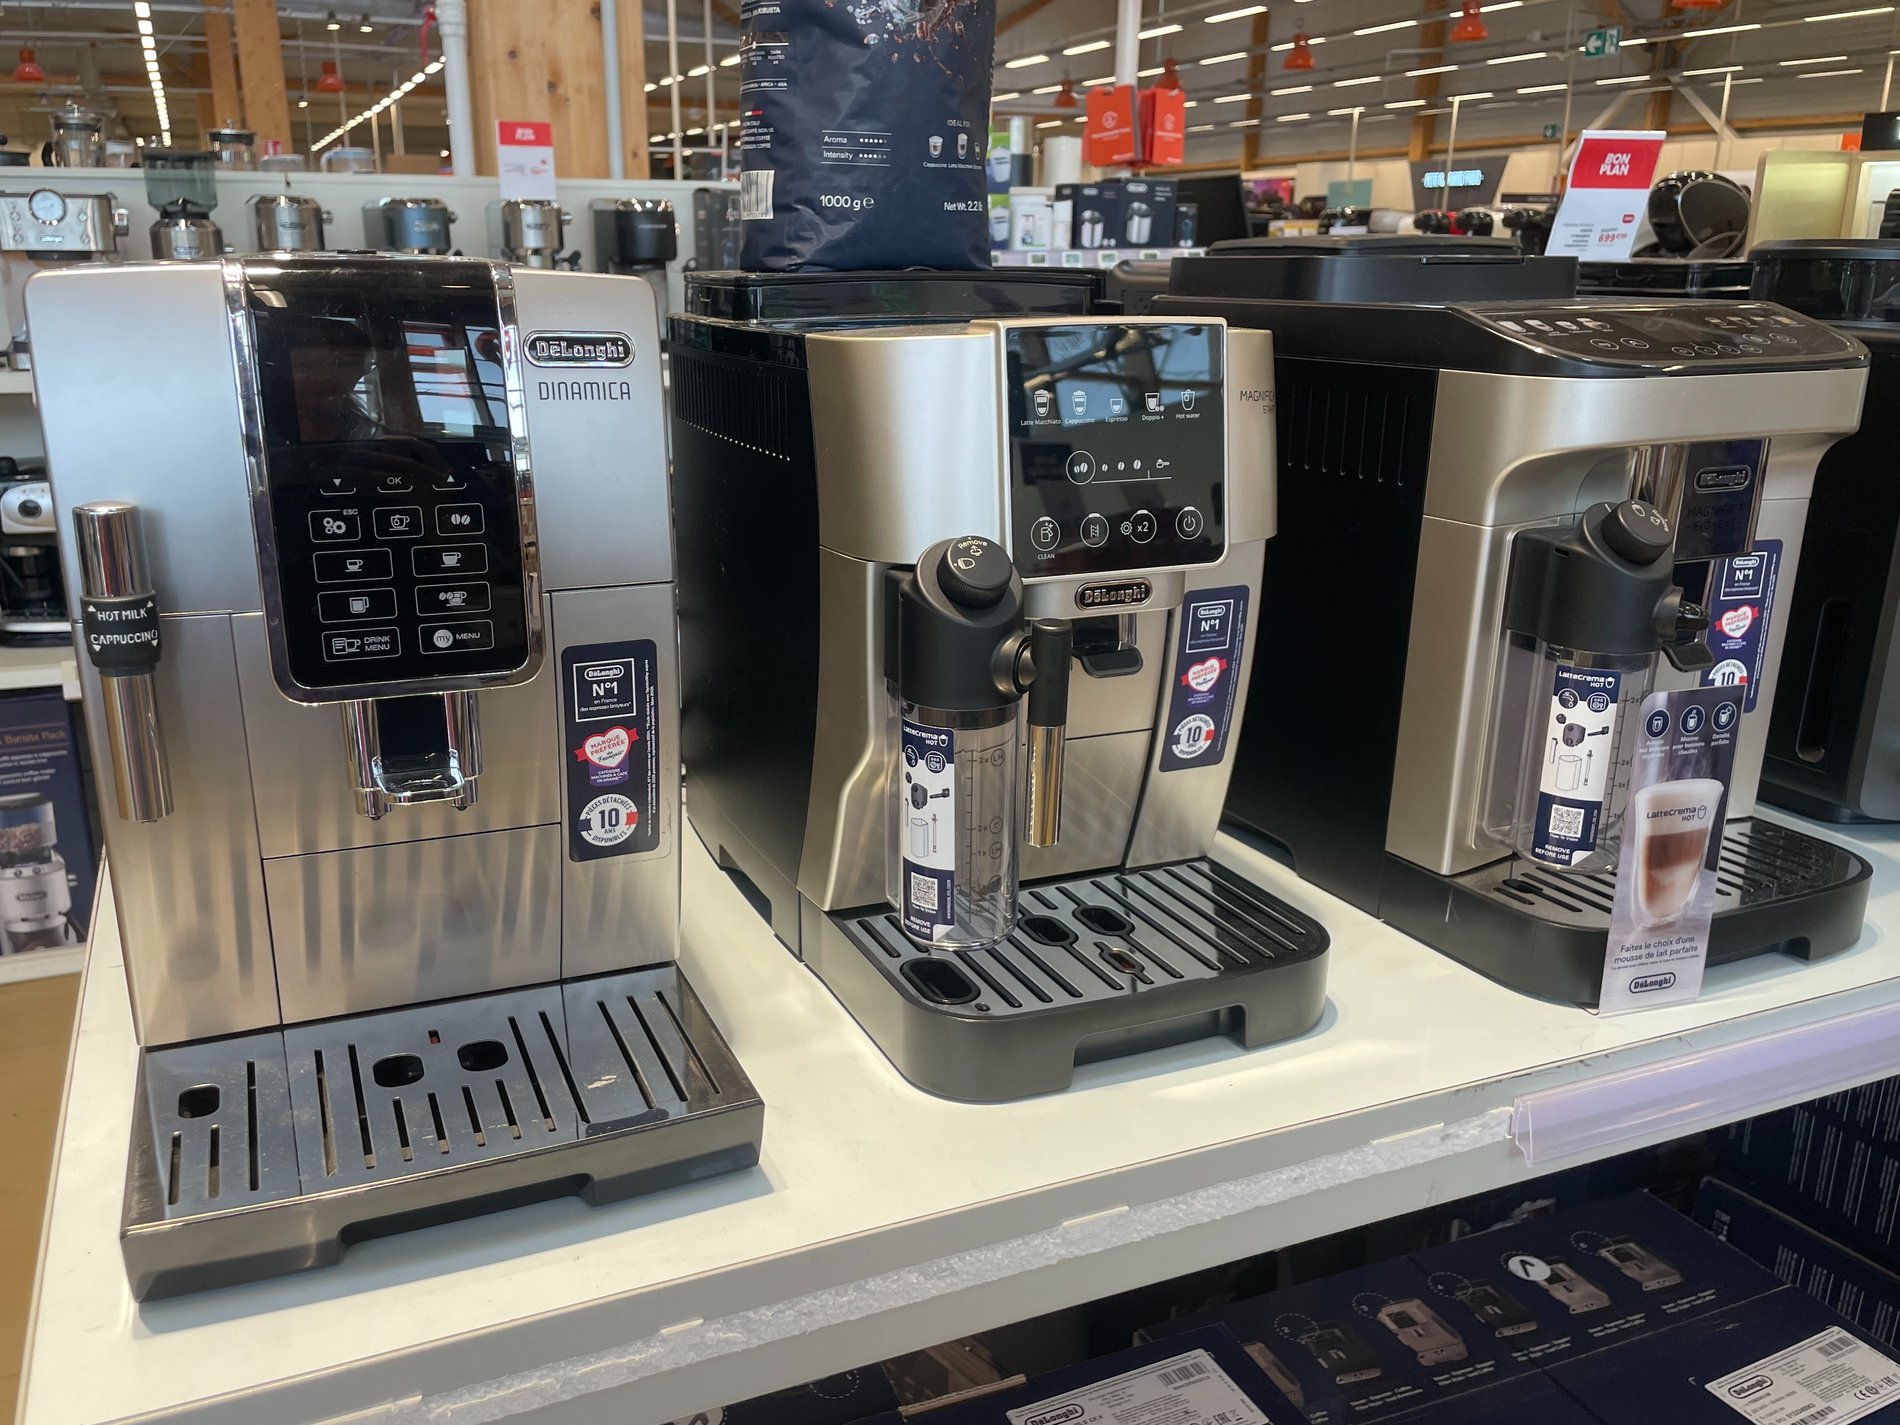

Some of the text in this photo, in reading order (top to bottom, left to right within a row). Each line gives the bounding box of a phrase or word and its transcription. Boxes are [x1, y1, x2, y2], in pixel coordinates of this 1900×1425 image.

[824, 151, 853, 160] Intensity
[1604, 153, 1631, 164] BON
[1599, 164, 1629, 176] PLAN
[820, 195, 850, 207] 1000
[853, 199, 860, 210] g
[944, 202, 956, 210] Net
[968, 201, 978, 211] 2.2
[538, 382, 631, 400] DINAMICA
[1137, 521, 1149, 532] x2
[958, 540, 988, 549] Remove
[97, 608, 147, 621] HOT MILK
[91, 630, 158, 644] CAPPUCCINO
[364, 635, 390, 644] DRINK
[436, 635, 450, 644] my
[365, 644, 390, 652] MENU
[1559, 671, 1605, 682] LatteCrema
[1721, 672, 1735, 685] 10
[1186, 726, 1202, 743] 10
[591, 735, 621, 749] MARQUE
[586, 800, 603, 816] PIÈCES
[603, 796, 632, 810] DÉTACHÉES
[599, 808, 619, 828] 10
[1647, 807, 1697, 818] LatteCrema
[592, 830, 627, 843] DISPONIBLES
[1535, 848, 1556, 858] BEFORE
[1545, 844, 1570, 854] REMOVE
[905, 919, 920, 931] BEFORE
[910, 916, 930, 927] REMOVE
[1620, 944, 1642, 953] Faites
[1653, 939, 1673, 948] choix
[1675, 936, 1695, 944] d'une
[1614, 954, 1643, 963] mousse
[1669, 946, 1698, 957] parfaite
